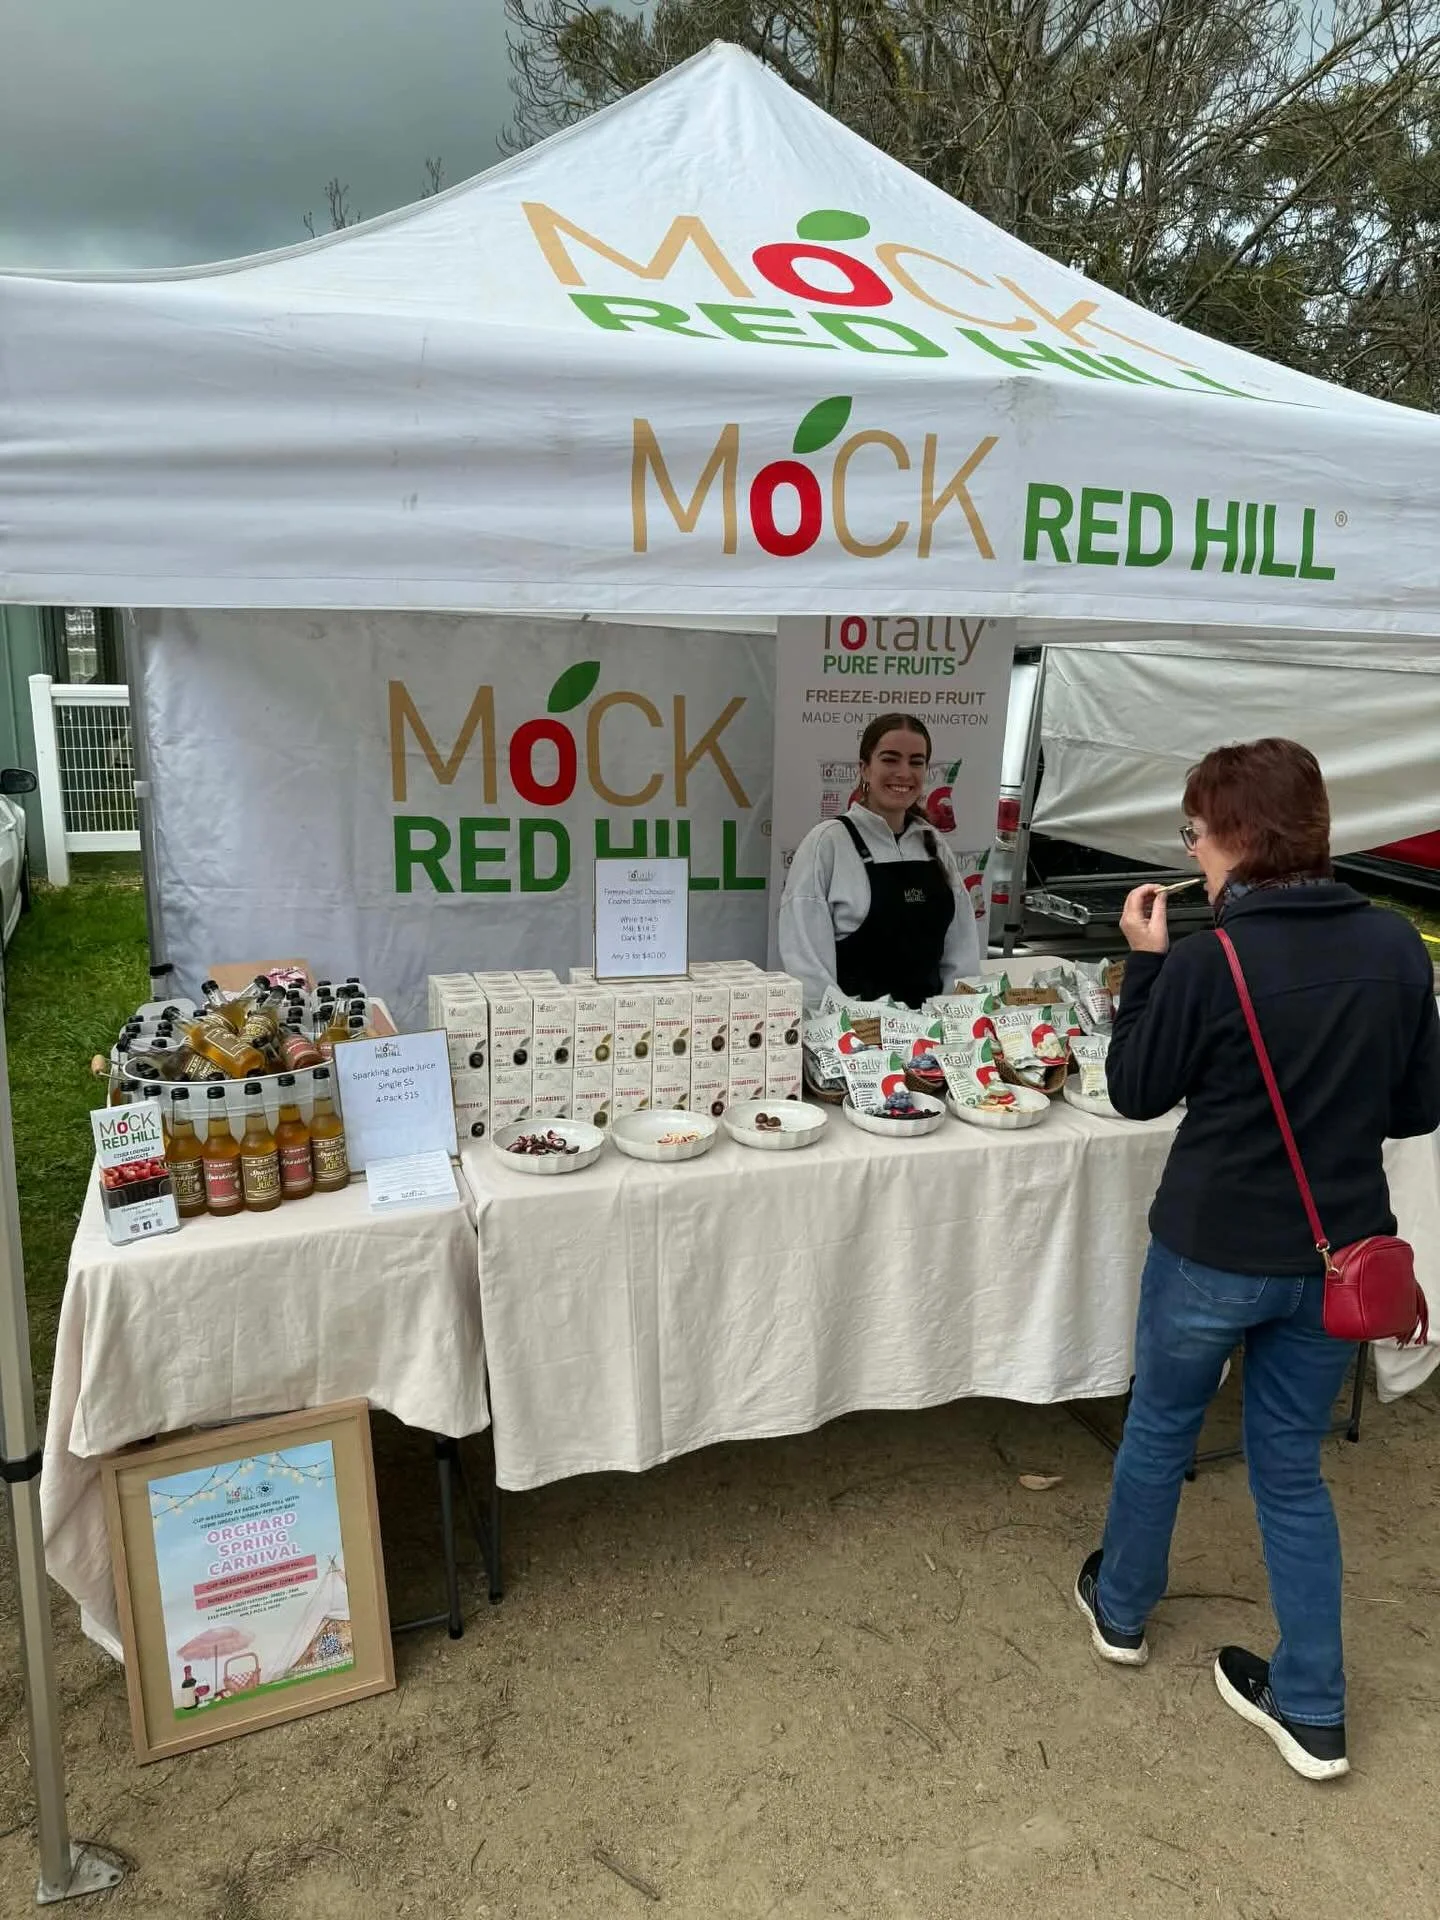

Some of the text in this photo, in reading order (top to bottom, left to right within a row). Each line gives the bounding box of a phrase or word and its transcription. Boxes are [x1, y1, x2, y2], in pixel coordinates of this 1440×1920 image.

[567, 293, 948, 358] RED
[1023, 482, 1173, 567] RED
[1190, 497, 1336, 580] HILL
[823, 655, 955, 675] PURE FRUITS
[805, 689, 985, 705] FREEZE-DRIED FRUIT
[802, 711, 841, 723] MADE
[843, 712, 863, 723] ON
[393, 815, 766, 893] RED HILL
[352, 1063, 436, 1080] Sparkling Apple Juice
[378, 1081, 402, 1090] Single
[404, 1091, 420, 1100] $15
[102, 1129, 160, 1150] RED HILL
[206, 1512, 296, 1544] ORCHARD
[219, 1530, 287, 1557] SPRING
[209, 1543, 301, 1576] CARNIVAL
